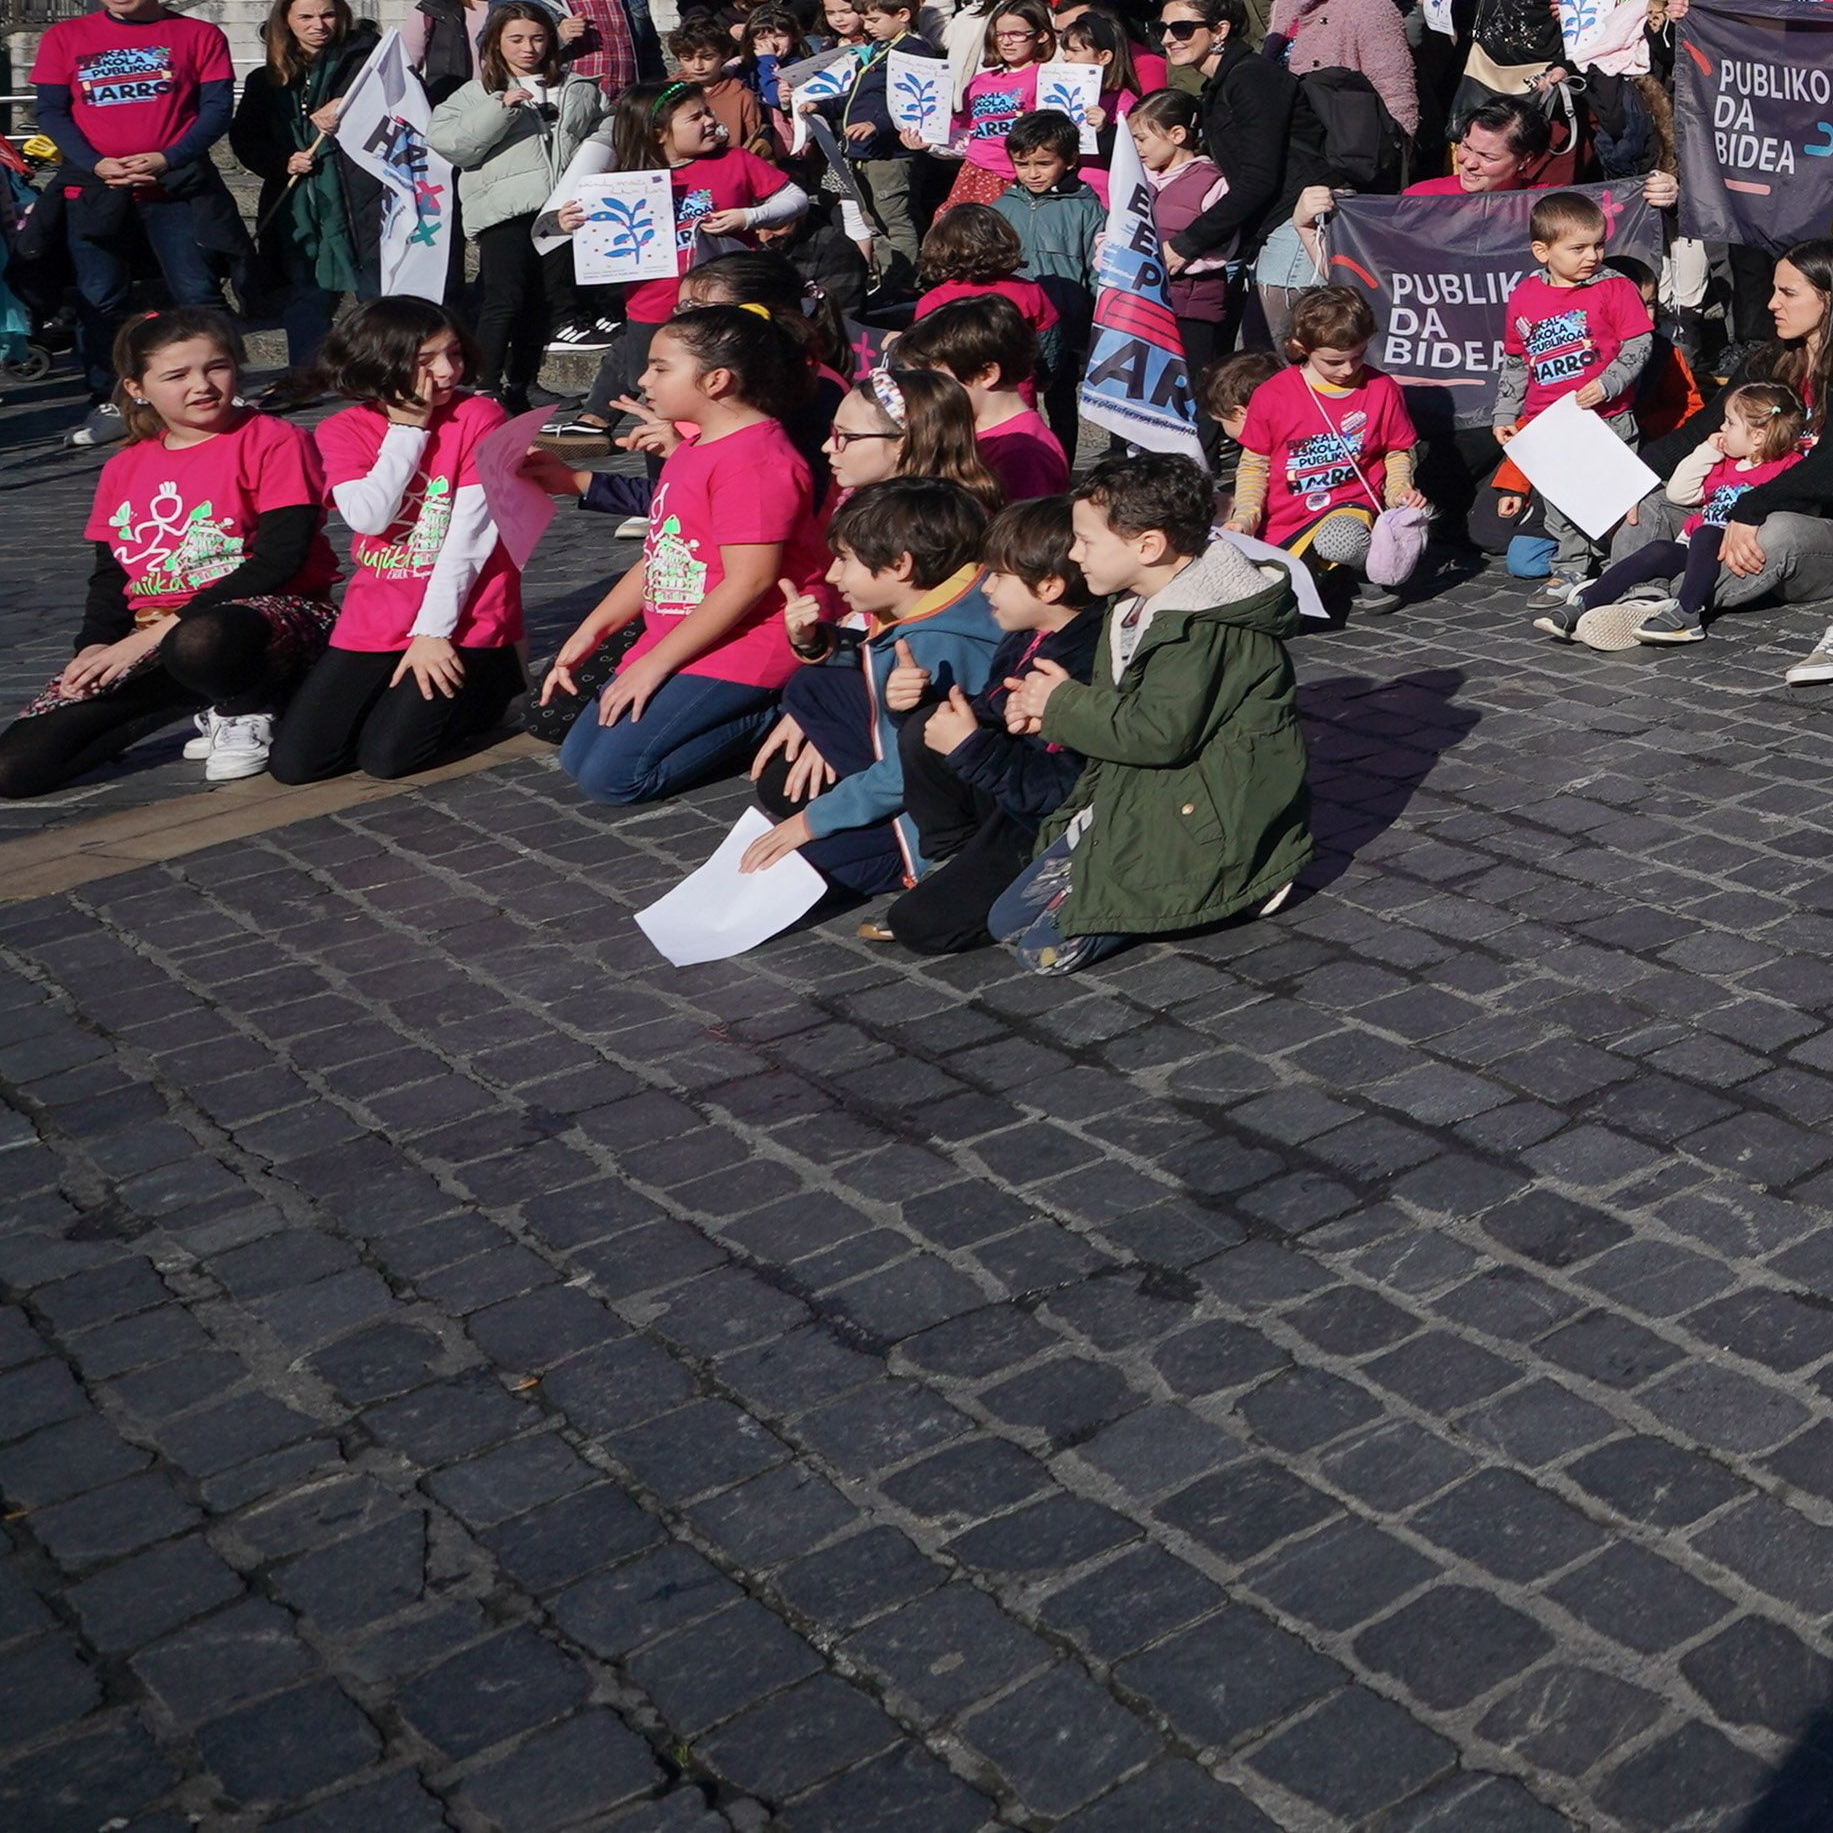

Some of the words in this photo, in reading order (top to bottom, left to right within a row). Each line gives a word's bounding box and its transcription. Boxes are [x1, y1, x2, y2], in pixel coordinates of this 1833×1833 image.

[1712, 95, 1756, 133] DA
[1713, 132, 1797, 176] BIDEA
[1391, 272, 1523, 306] PUBLIK
[1387, 307, 1448, 339] DA
